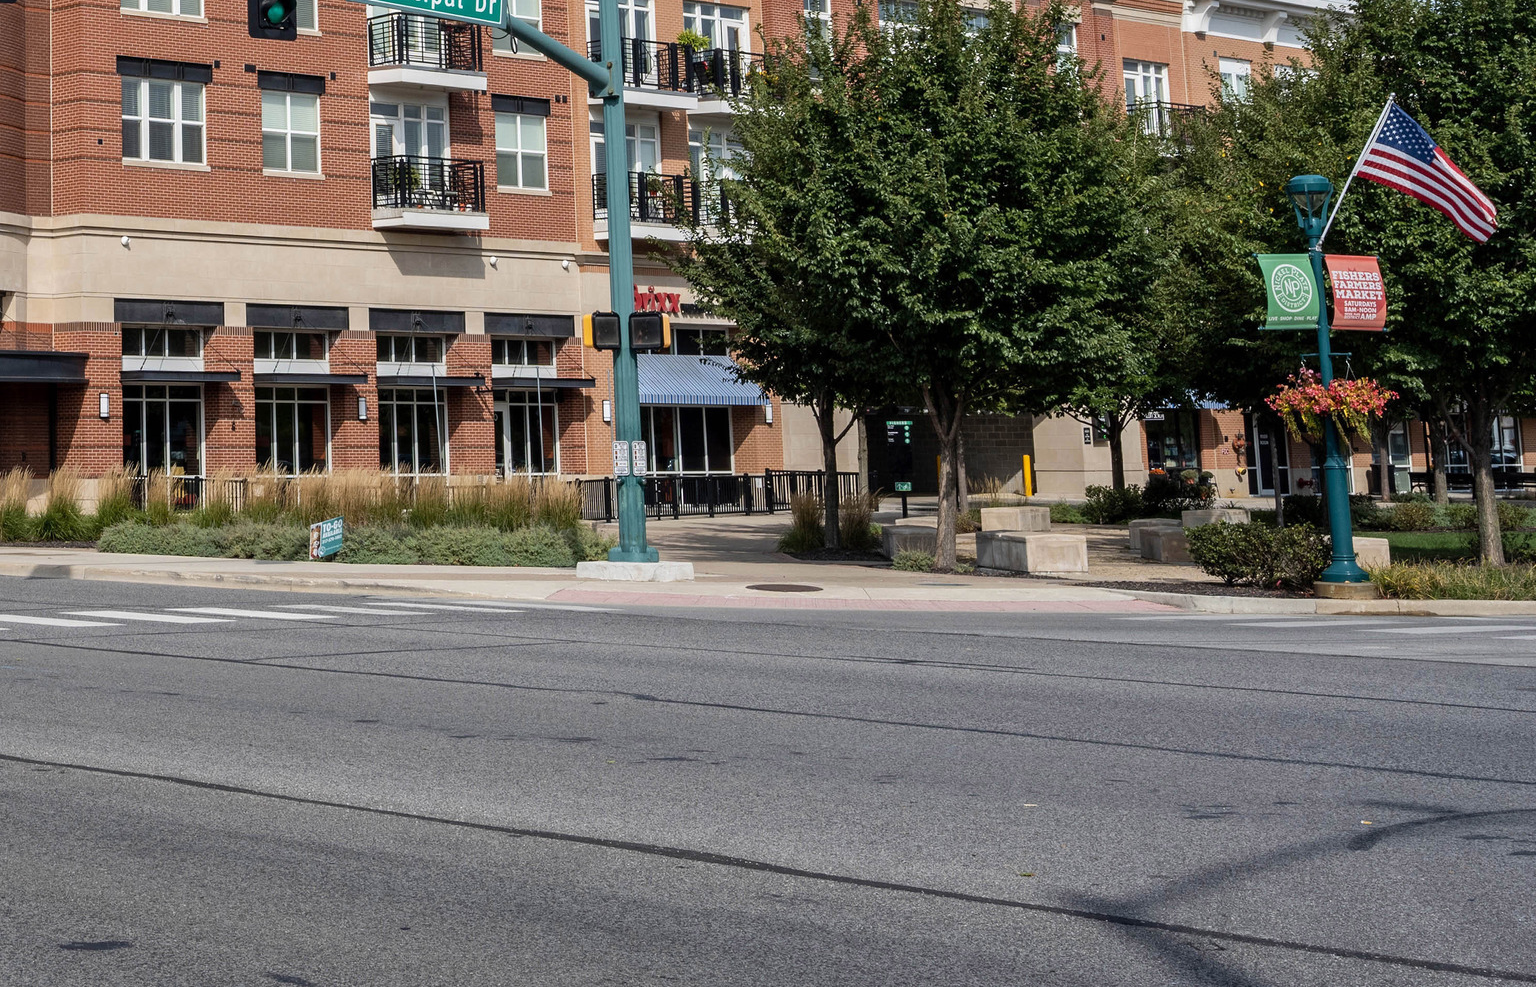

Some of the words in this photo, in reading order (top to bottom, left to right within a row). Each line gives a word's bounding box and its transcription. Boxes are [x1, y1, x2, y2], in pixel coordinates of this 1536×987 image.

[1331, 270, 1380, 281] FISHERS
[1284, 278, 1300, 298] NP
[1335, 289, 1383, 300] MARKET
[1344, 300, 1376, 308] SATURDAYS
[323, 519, 342, 532] TO-GO
